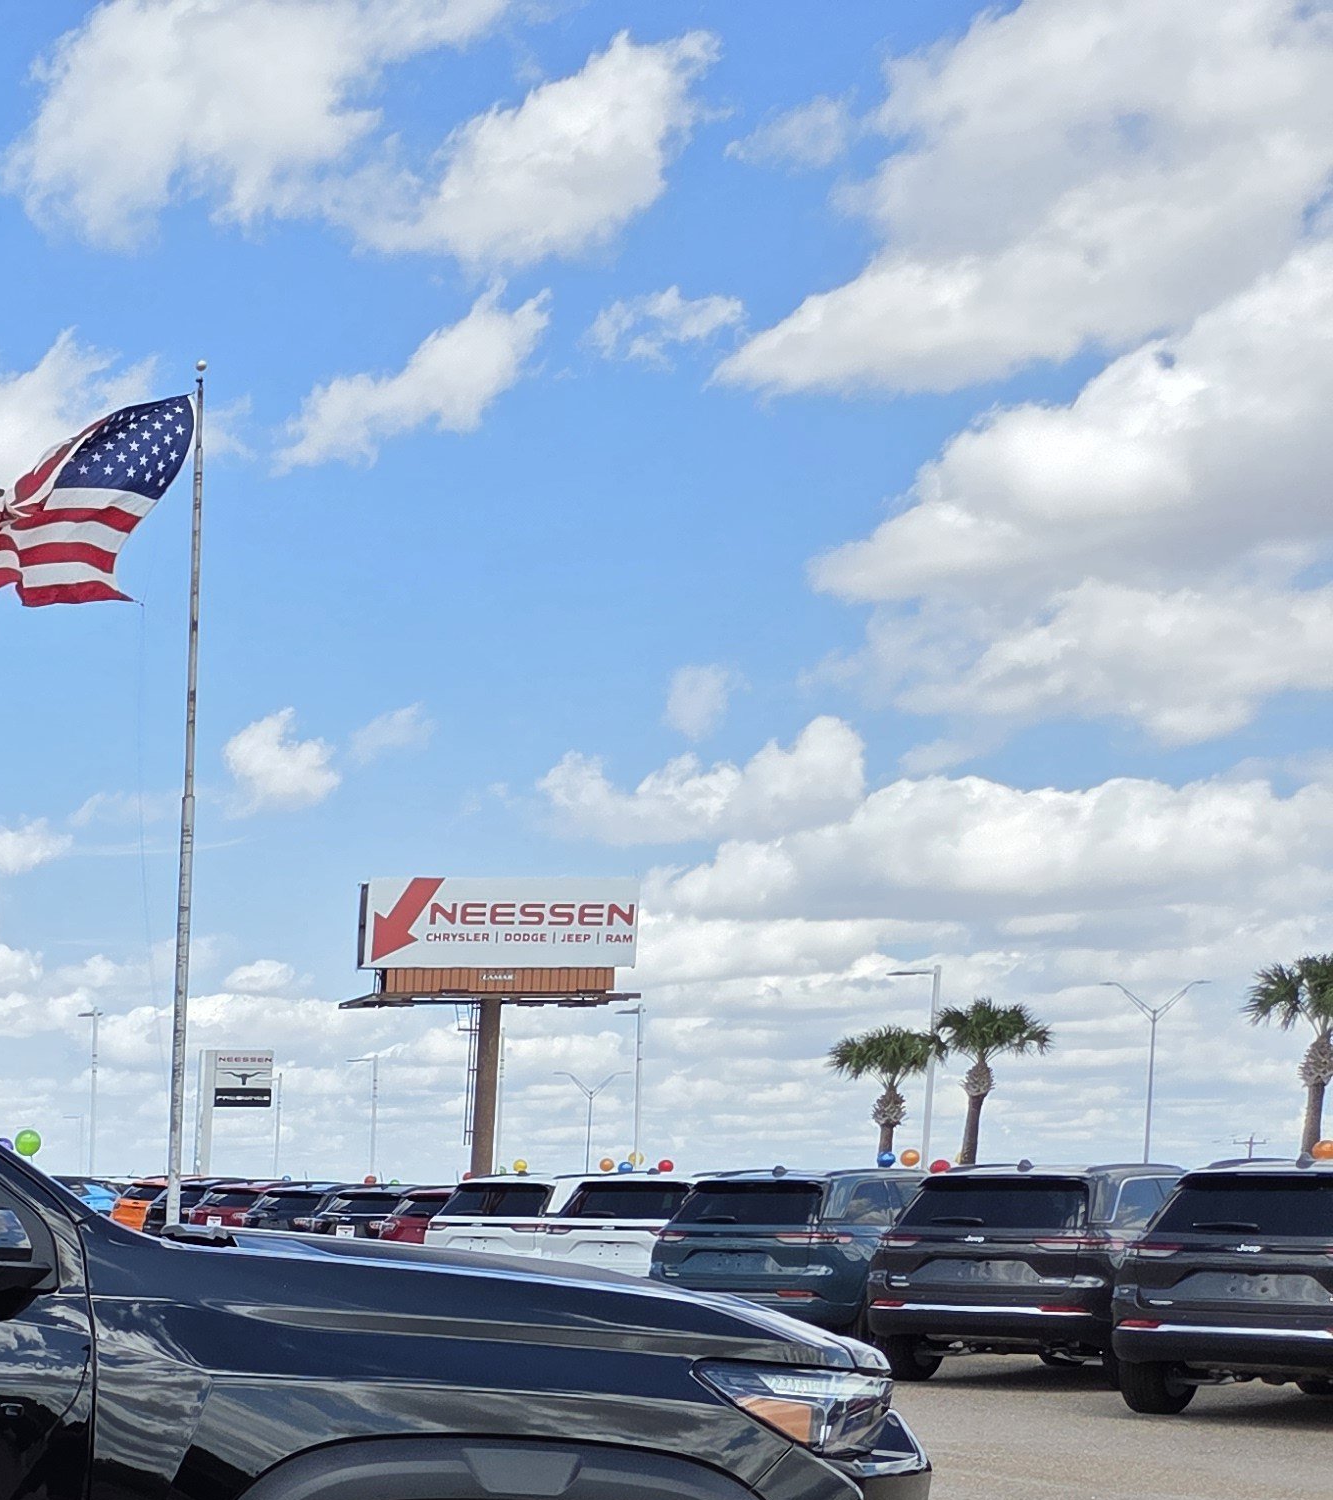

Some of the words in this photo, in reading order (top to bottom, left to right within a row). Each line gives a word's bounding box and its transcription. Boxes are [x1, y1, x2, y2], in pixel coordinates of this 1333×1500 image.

[429, 902, 635, 927] NEESSEN
[425, 932, 490, 943] CHRYSLER
[504, 933, 547, 943] DODGE
[561, 933, 591, 943] JEEP
[605, 934, 633, 944] RAM
[1236, 1243, 1262, 1253] Jeep
